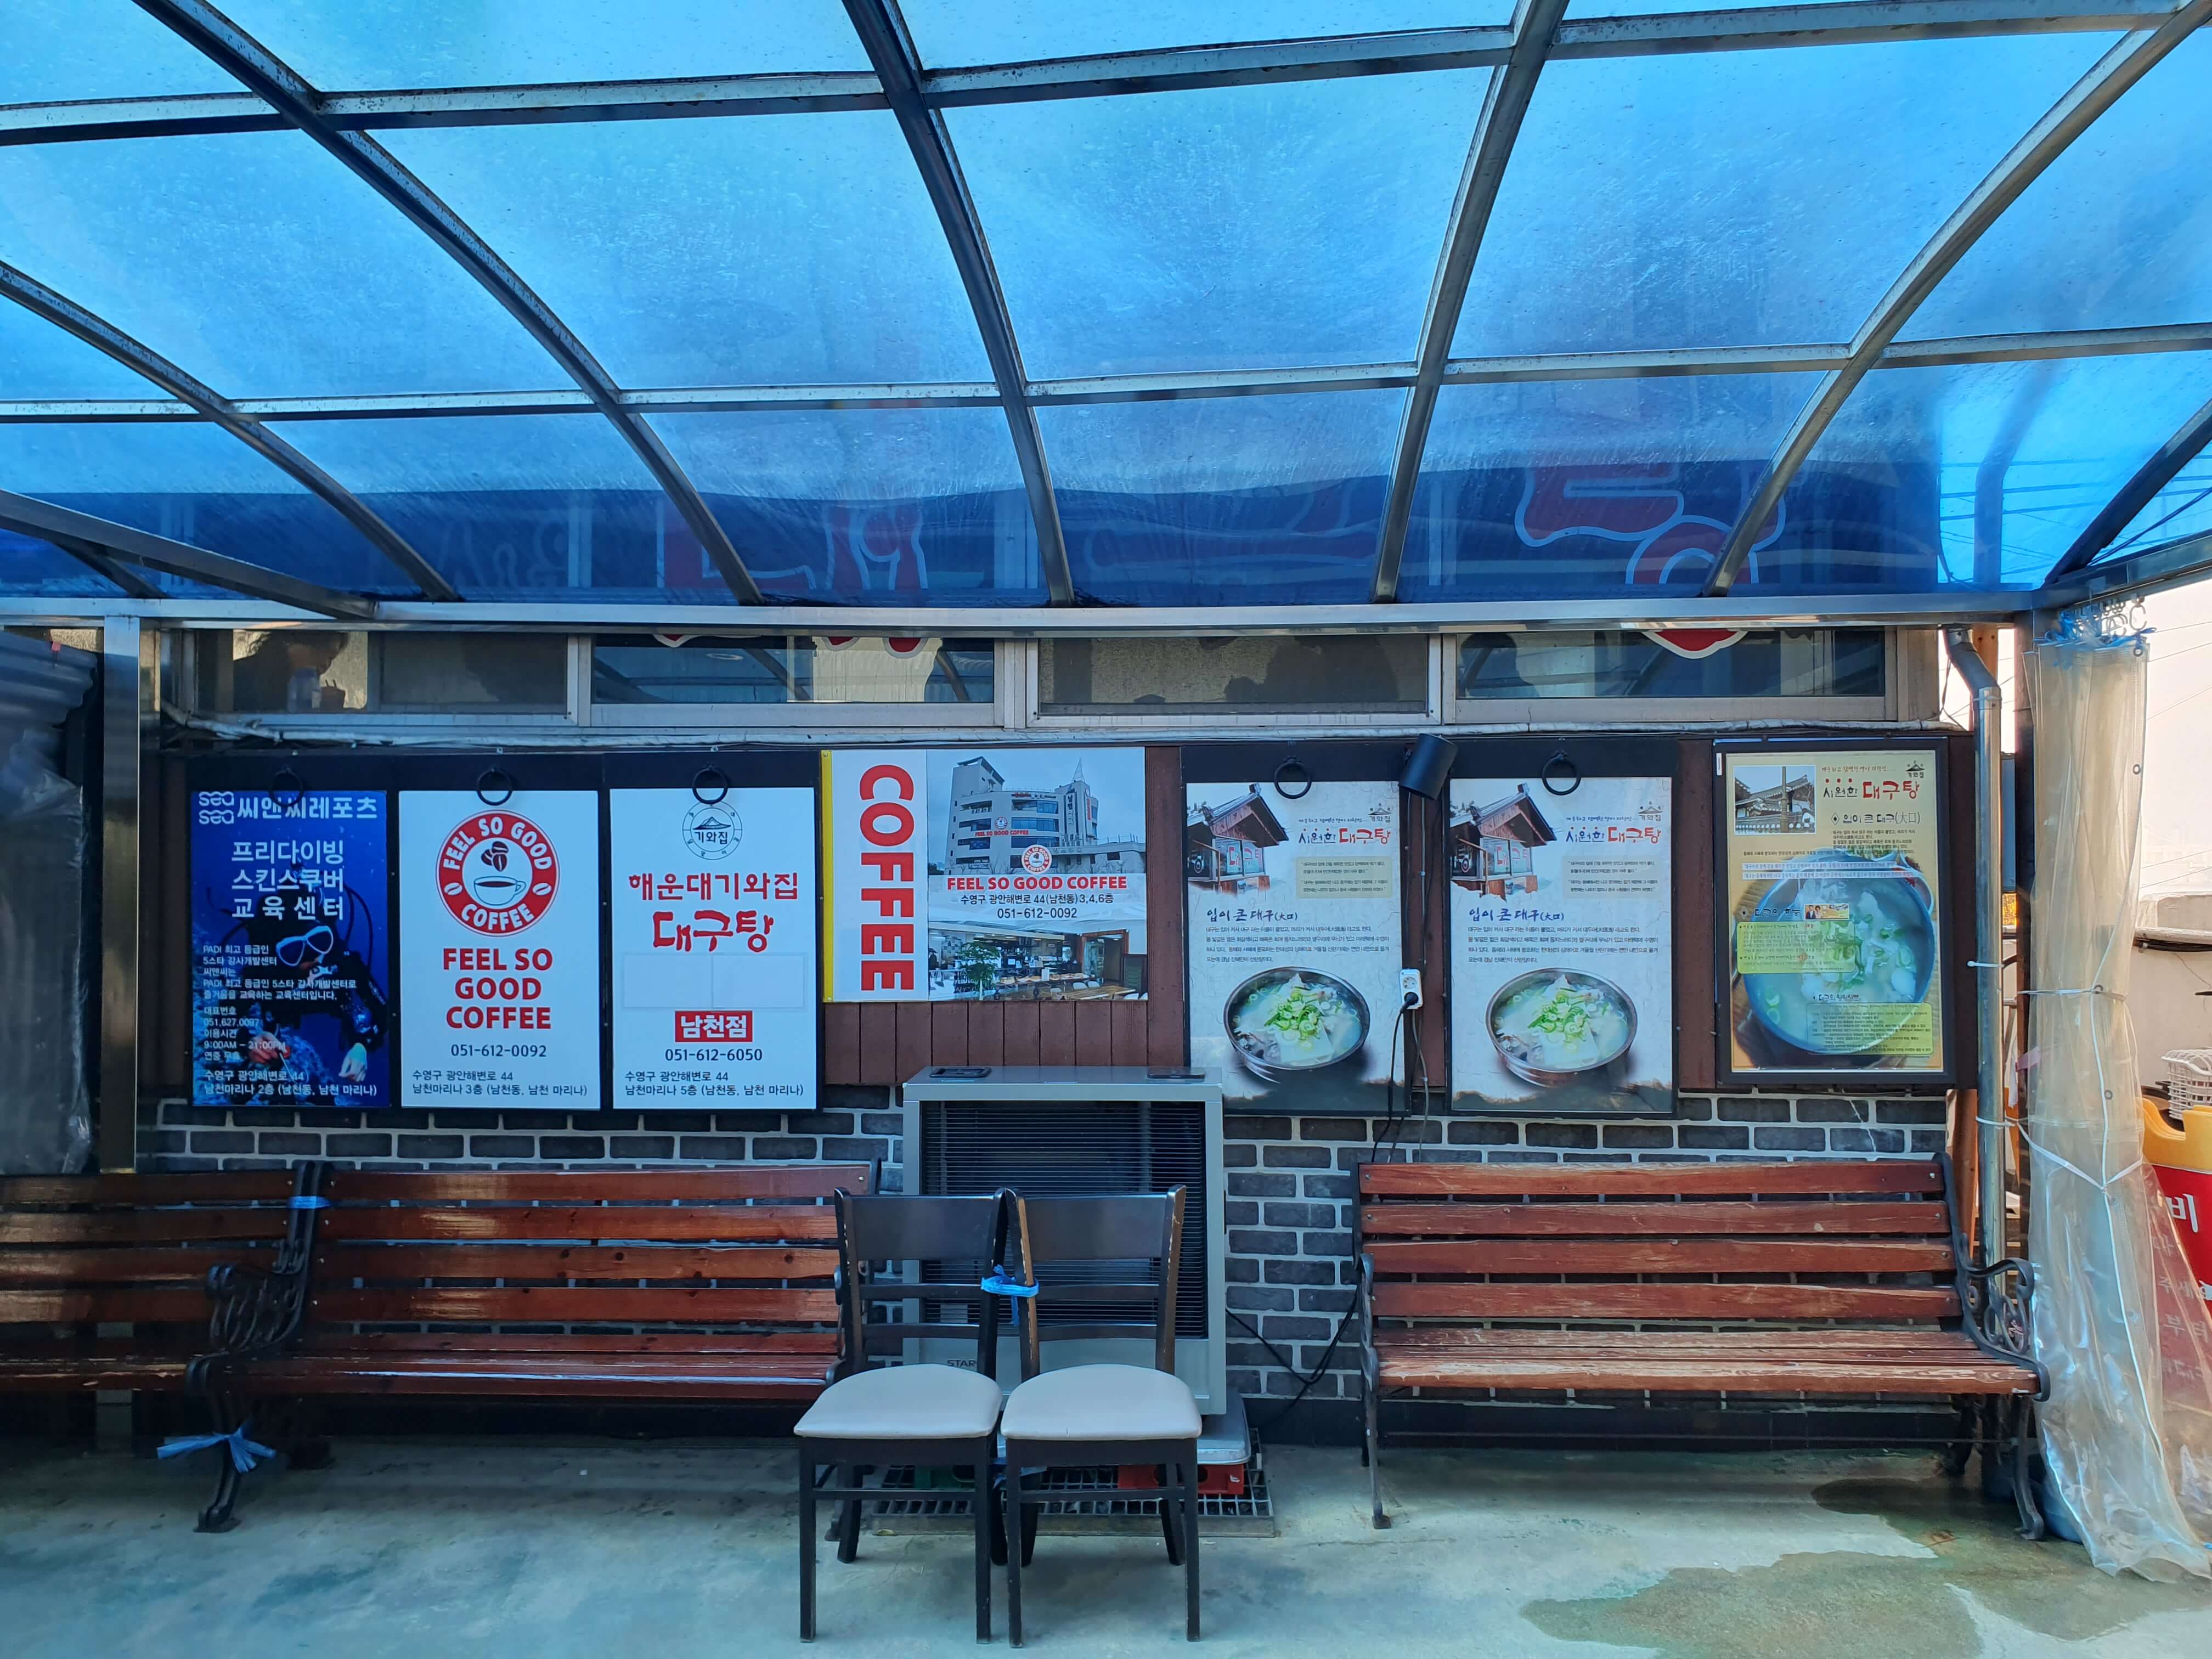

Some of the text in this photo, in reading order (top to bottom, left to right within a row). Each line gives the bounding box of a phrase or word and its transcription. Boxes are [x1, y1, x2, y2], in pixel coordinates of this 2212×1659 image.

[1824, 781, 1920, 800] 시원한 대구탕
[237, 797, 377, 819] 씨앤씨레포츠
[443, 816, 552, 870] FEEL SO GOOD
[694, 831, 727, 844] 기와집
[1299, 828, 1391, 844] 시원한 대구탕
[1566, 827, 1661, 844] 시원한 대구탕
[232, 840, 343, 865] 프리다이빙
[232, 868, 343, 893] 스킨스쿠버
[859, 764, 915, 991] COFFEE
[947, 876, 1127, 890] FEEL SO GOOD COFFEE
[629, 872, 798, 900] 해운대기와집
[961, 894, 986, 904] 수영구
[989, 894, 1031, 904] 광안해변로
[461, 902, 535, 931] COFFEE
[997, 907, 1077, 919] 051-612-0092
[1206, 909, 1230, 922] 입이
[1234, 909, 1248, 921] 큰
[1469, 907, 1493, 922] 입이
[1497, 908, 1511, 921] 큰
[652, 910, 774, 952] 대구탕
[443, 947, 553, 970] FEEL SO
[455, 977, 542, 1000] GOOD
[446, 1007, 551, 1029] COFFEE
[681, 1014, 747, 1038] 남천점
[450, 1044, 547, 1057] 051-612-0092
[665, 1048, 763, 1061] 051-612-6050
[205, 1070, 234, 1081] 수영구
[412, 1070, 513, 1082] 수영구 광안해변로 44
[625, 1071, 729, 1082] 수영구 광안해변로 44
[205, 1084, 255, 1096] 남천마리나
[412, 1084, 462, 1096] 남천마리나
[465, 1084, 483, 1096] 3층
[528, 1084, 549, 1096] 남천
[553, 1084, 588, 1097] 마리나)
[625, 1084, 676, 1096] 남천마리나
[681, 1084, 697, 1096] 5층
[743, 1084, 764, 1096] 남천
[769, 1084, 803, 1097] 마리나)
